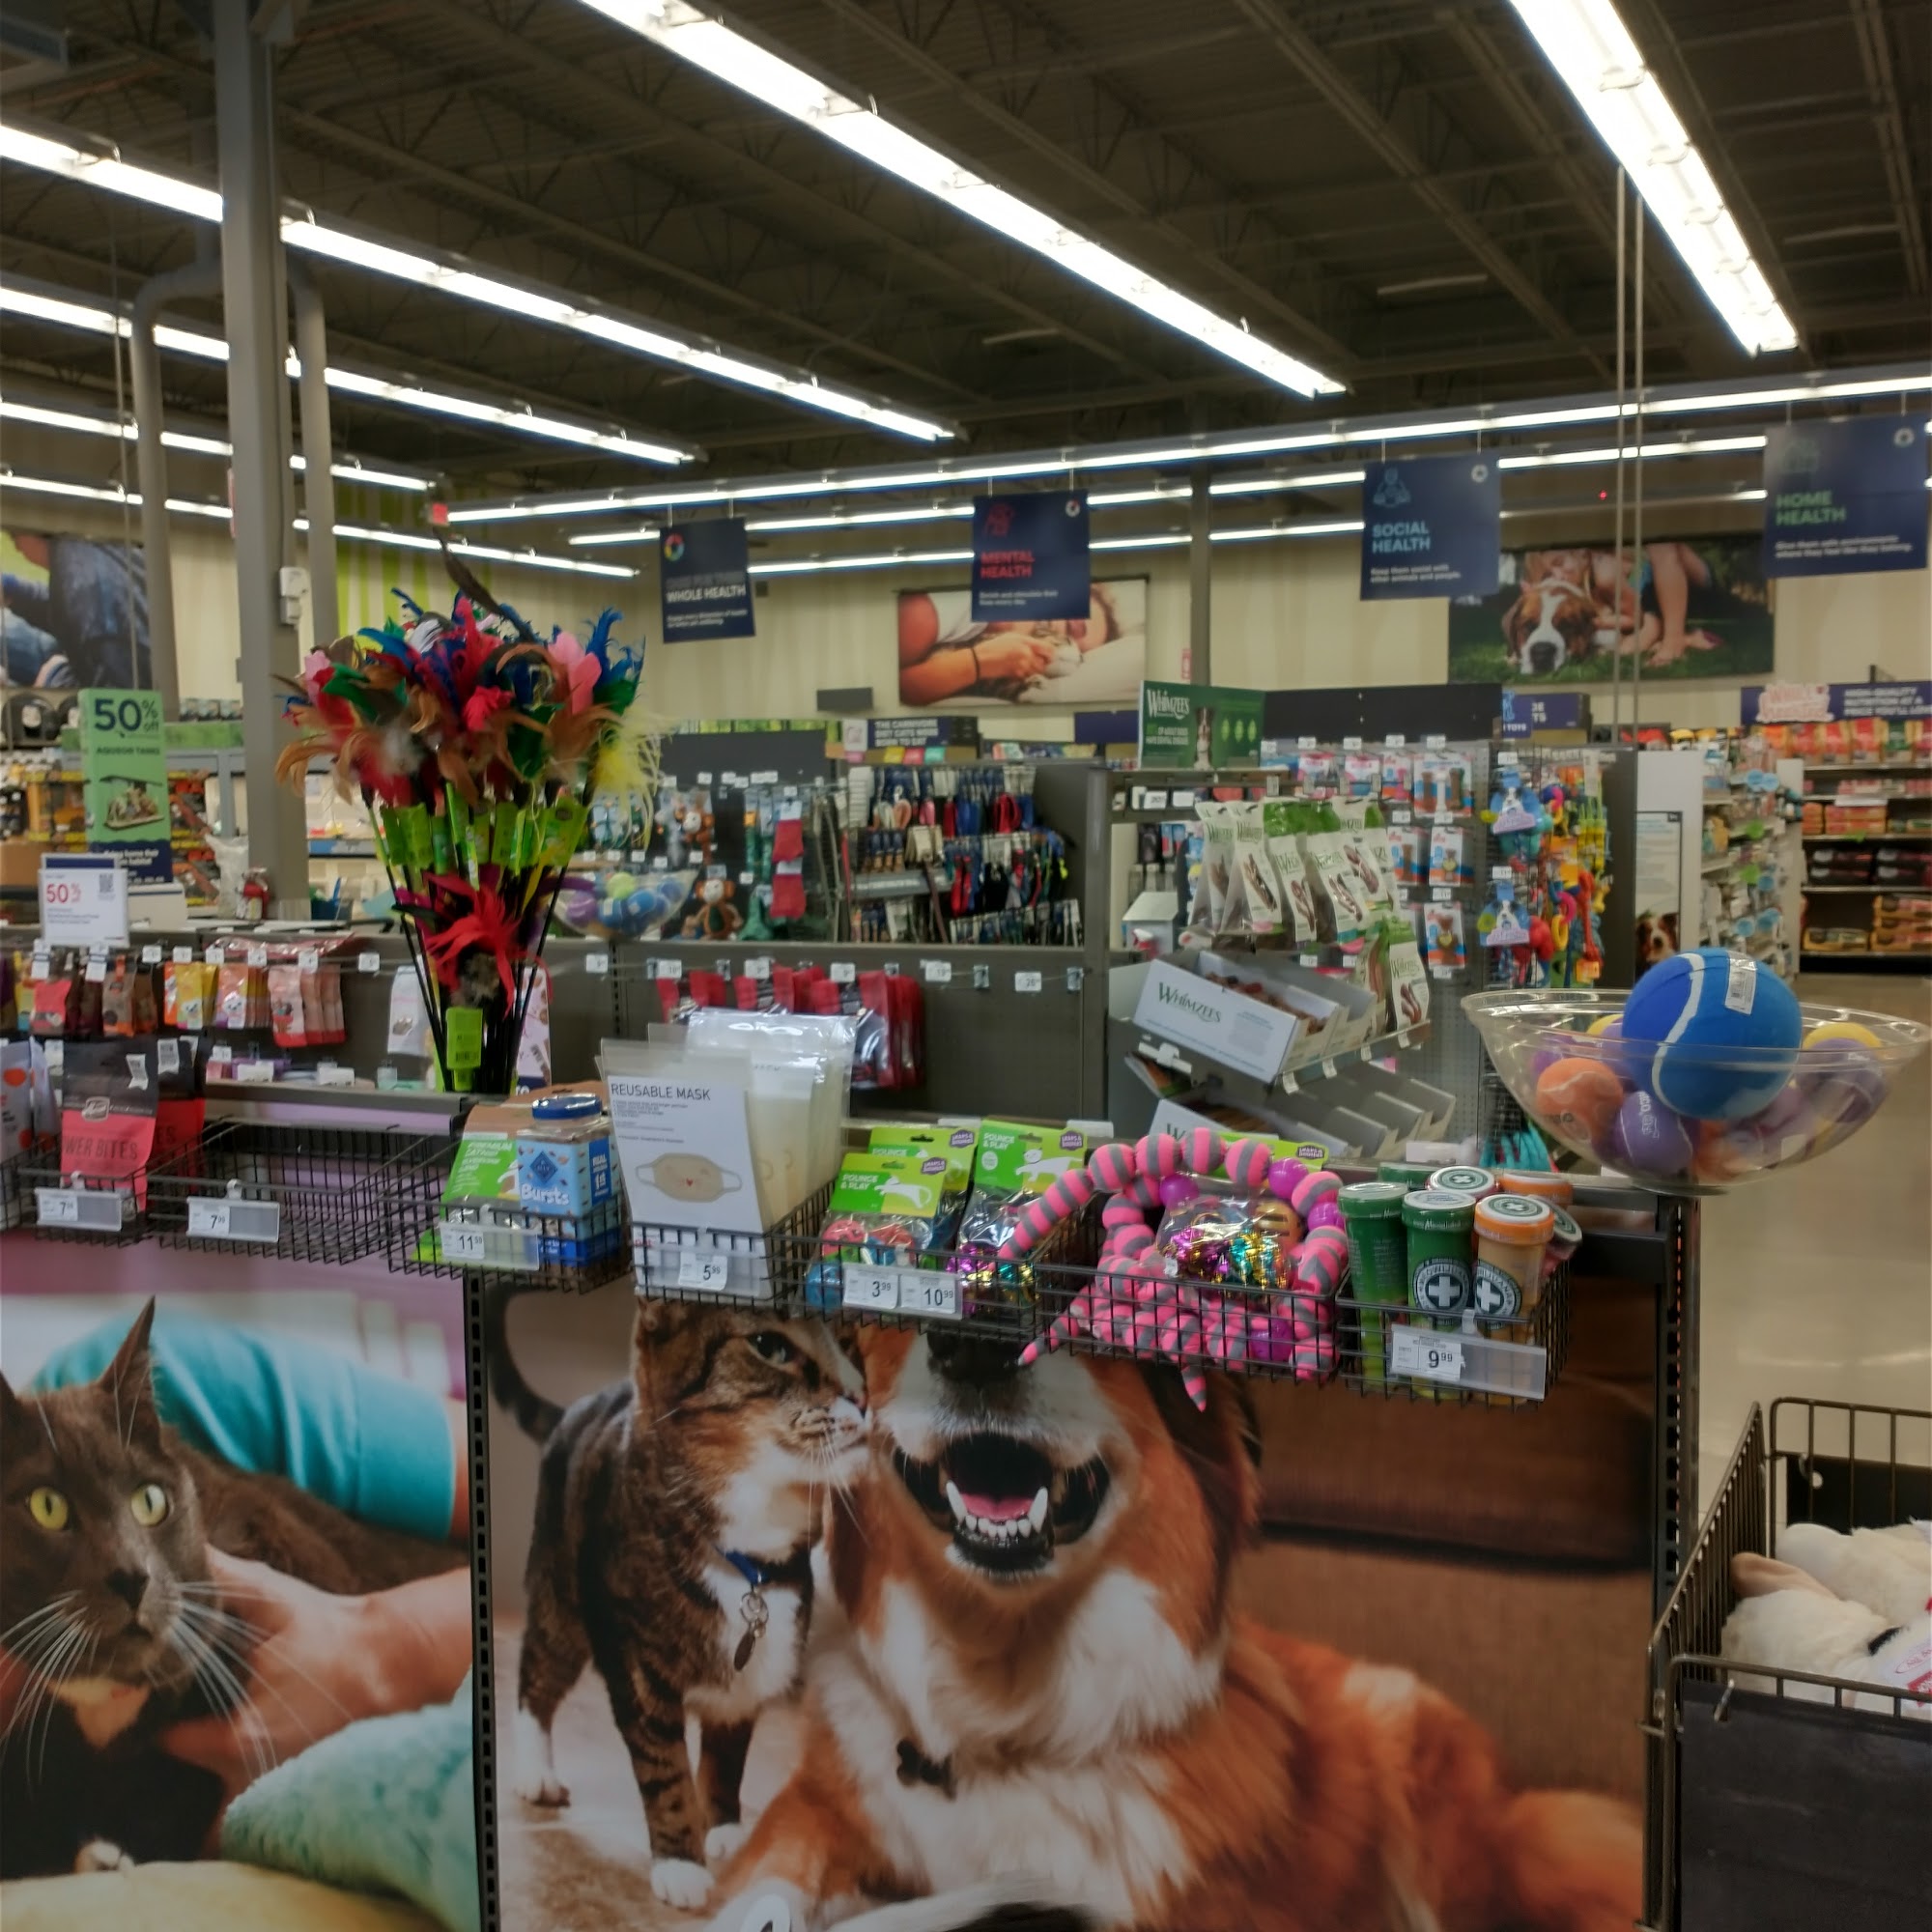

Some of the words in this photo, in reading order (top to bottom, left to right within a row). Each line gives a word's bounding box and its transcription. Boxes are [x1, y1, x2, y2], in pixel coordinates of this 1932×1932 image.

[1776, 491, 1833, 509] HOME
[1776, 506, 1847, 526] HEALTH
[1372, 521, 1430, 539] SOCIAL
[1372, 536, 1432, 554] HEALTH
[980, 551, 1035, 564] MENTAL
[980, 564, 1033, 579] HEALTH
[667, 588, 702, 603] WHOLE
[703, 584, 746, 599] HEALTH
[611, 1083, 673, 1099] REUSABLE
[676, 1088, 711, 1101] MASK
[984, 1132, 1015, 1144] POUNCE
[989, 1141, 1009, 1150] PLAY
[97, 1138, 139, 1160] BITES
[842, 1174, 879, 1183] POUNCE
[522, 1183, 570, 1207] Bursts
